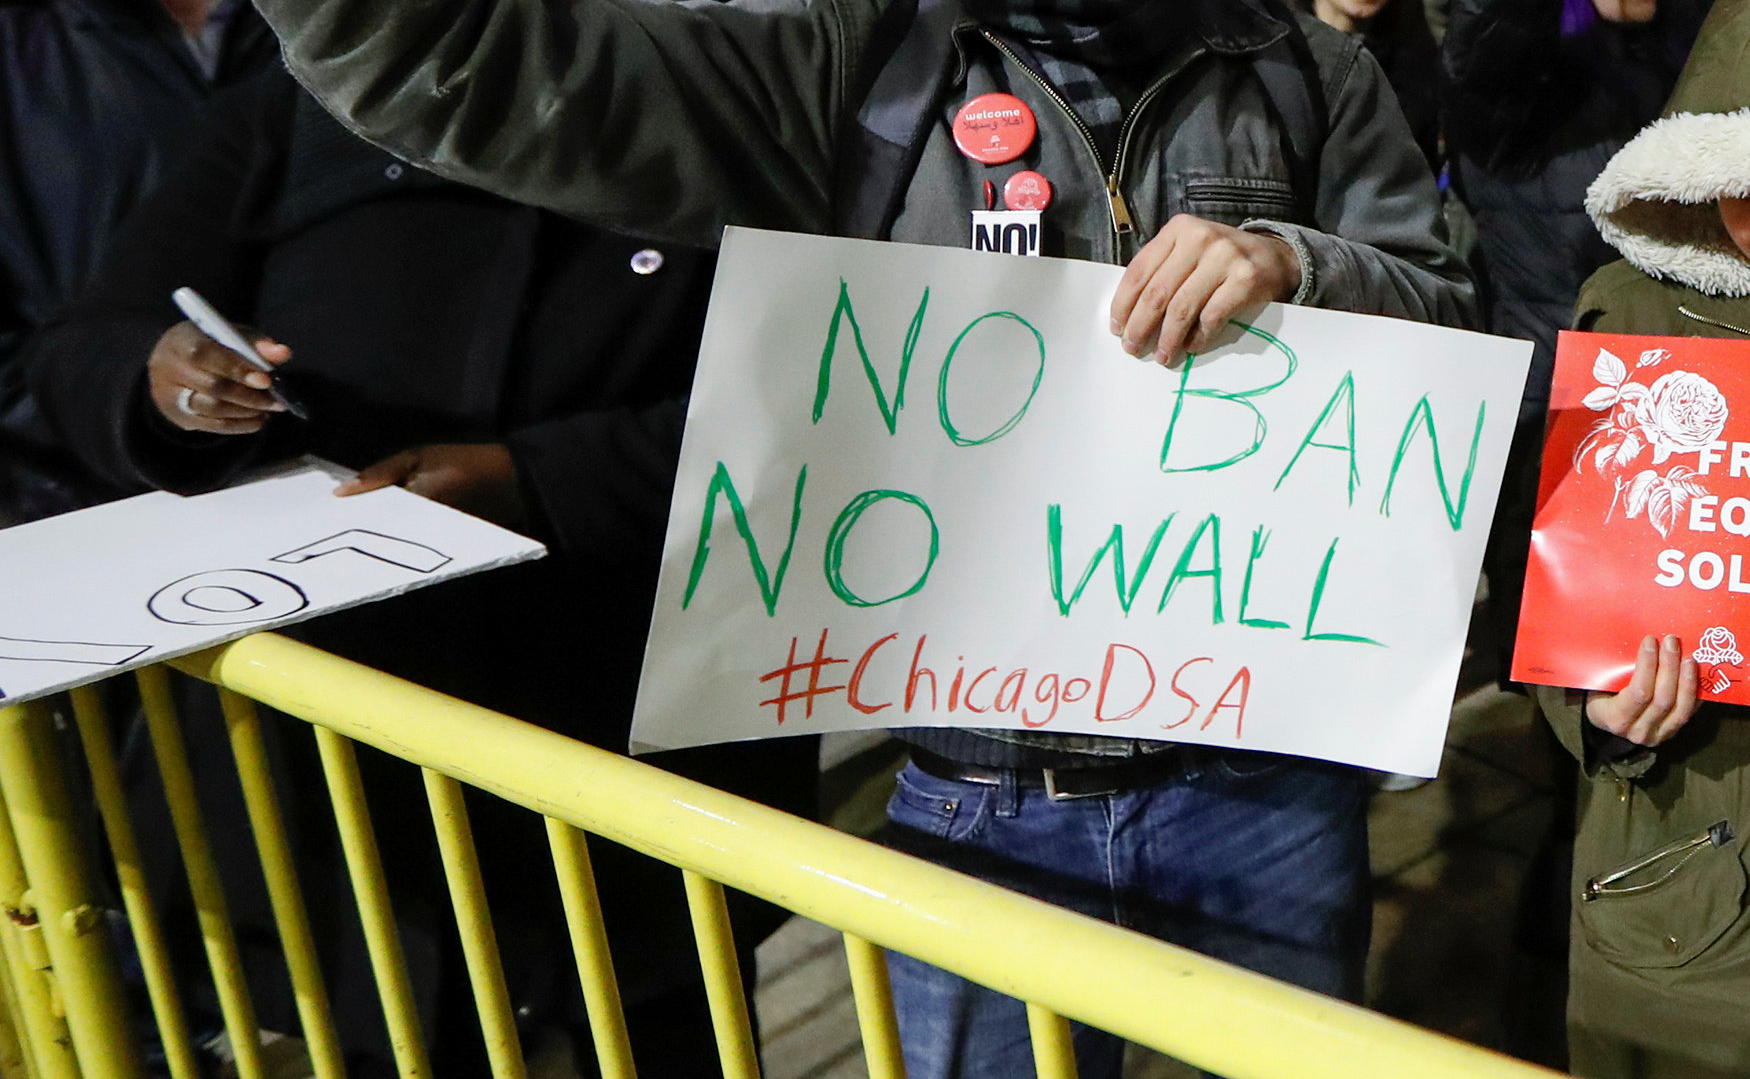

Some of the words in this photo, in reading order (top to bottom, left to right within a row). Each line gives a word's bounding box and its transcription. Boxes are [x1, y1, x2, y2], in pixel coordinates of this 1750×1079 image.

[965, 108, 1021, 121] welcome
[975, 222, 1038, 256] NO!
[812, 277, 1046, 447] NO
[1160, 320, 1487, 532] BAN
[682, 460, 942, 618] NO
[1046, 504, 1391, 647] WALL
[759, 627, 1251, 739] #ChicagoDSA
